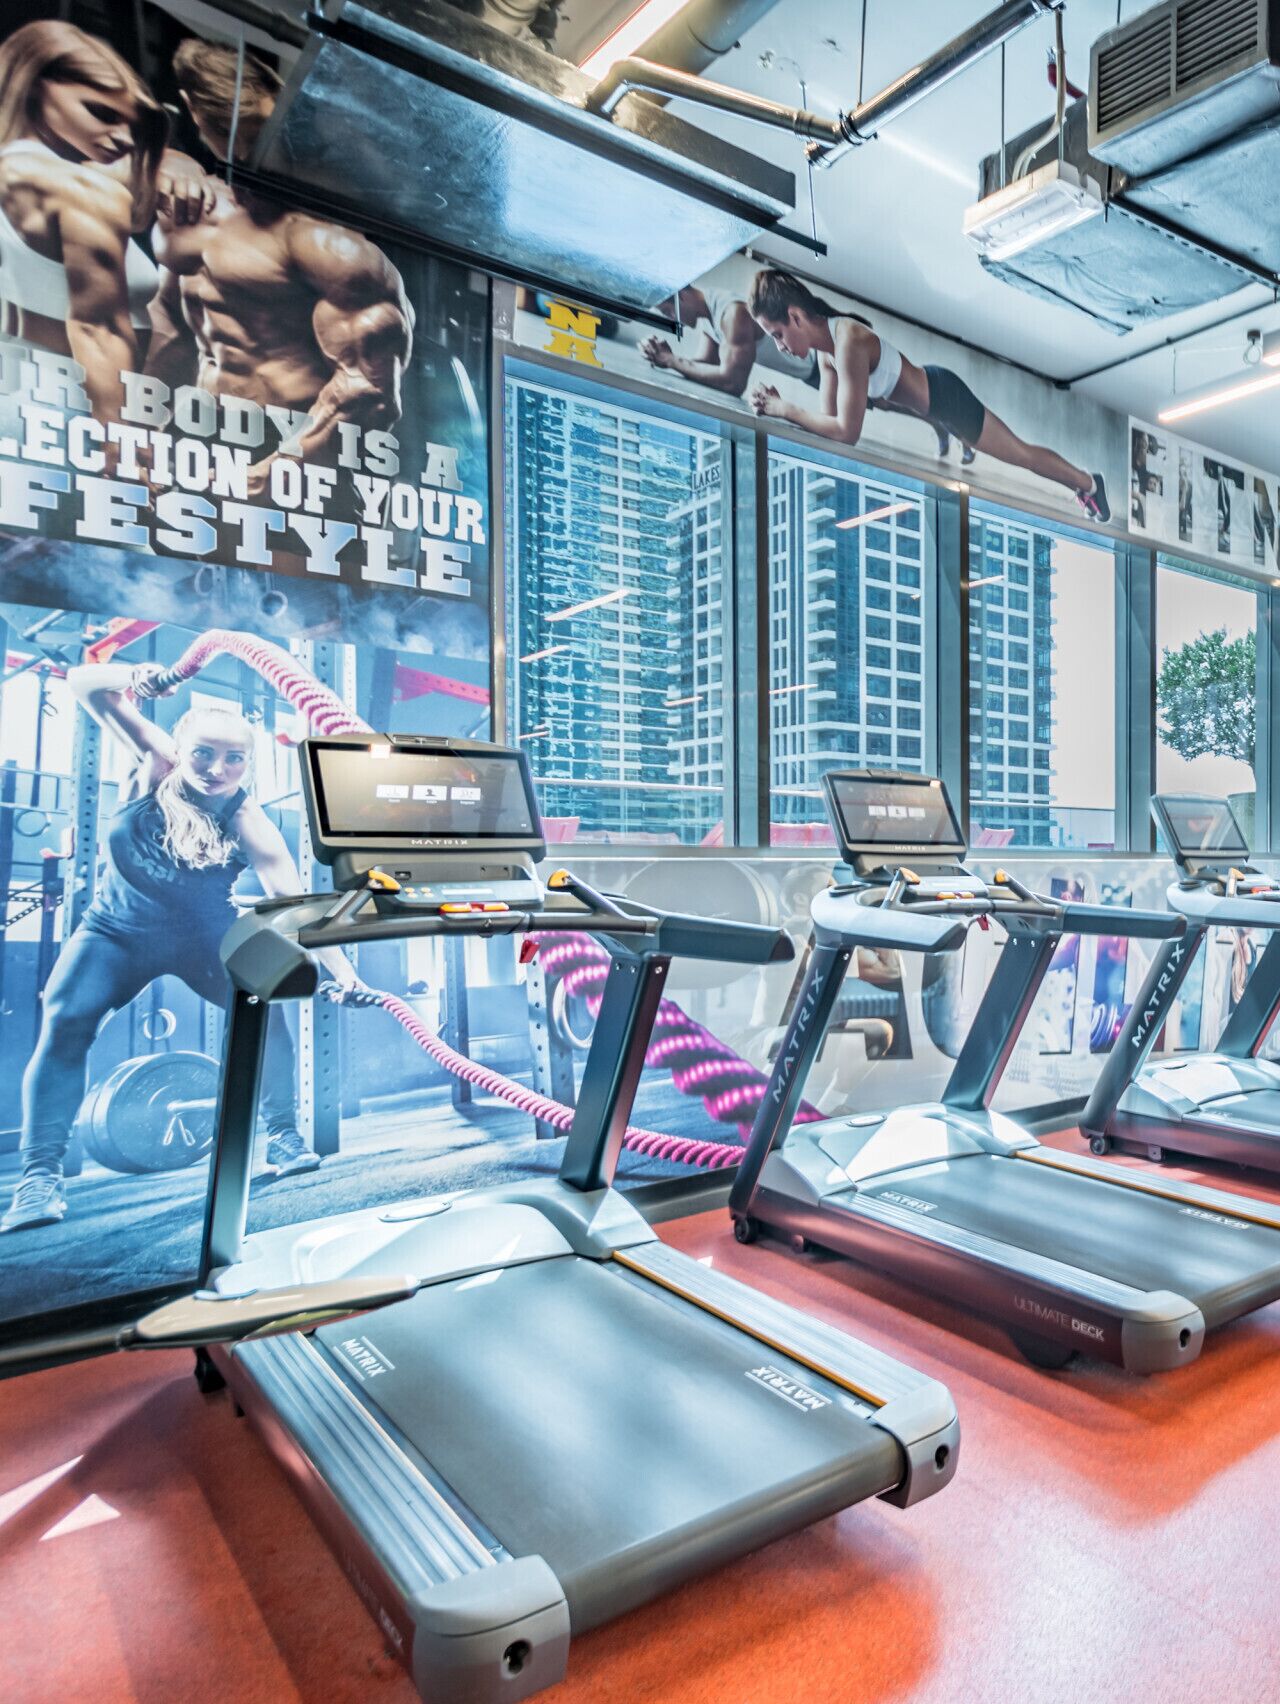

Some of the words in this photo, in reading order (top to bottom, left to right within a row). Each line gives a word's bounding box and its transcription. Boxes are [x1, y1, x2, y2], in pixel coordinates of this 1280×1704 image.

[0, 402, 252, 501] ECTION
[270, 457, 337, 515] OF
[352, 473, 486, 545] YOUR
[120, 369, 315, 458] BODY
[338, 421, 400, 478] IS
[421, 441, 464, 492] A
[772, 967, 824, 1103] MATRIX
[1131, 942, 1185, 1048] MATRIX
[341, 1338, 387, 1378] MATRIX
[1014, 1295, 1071, 1329] ULTIMATE
[1071, 1317, 1104, 1342] DECK
[751, 1366, 826, 1410] MATRIX
